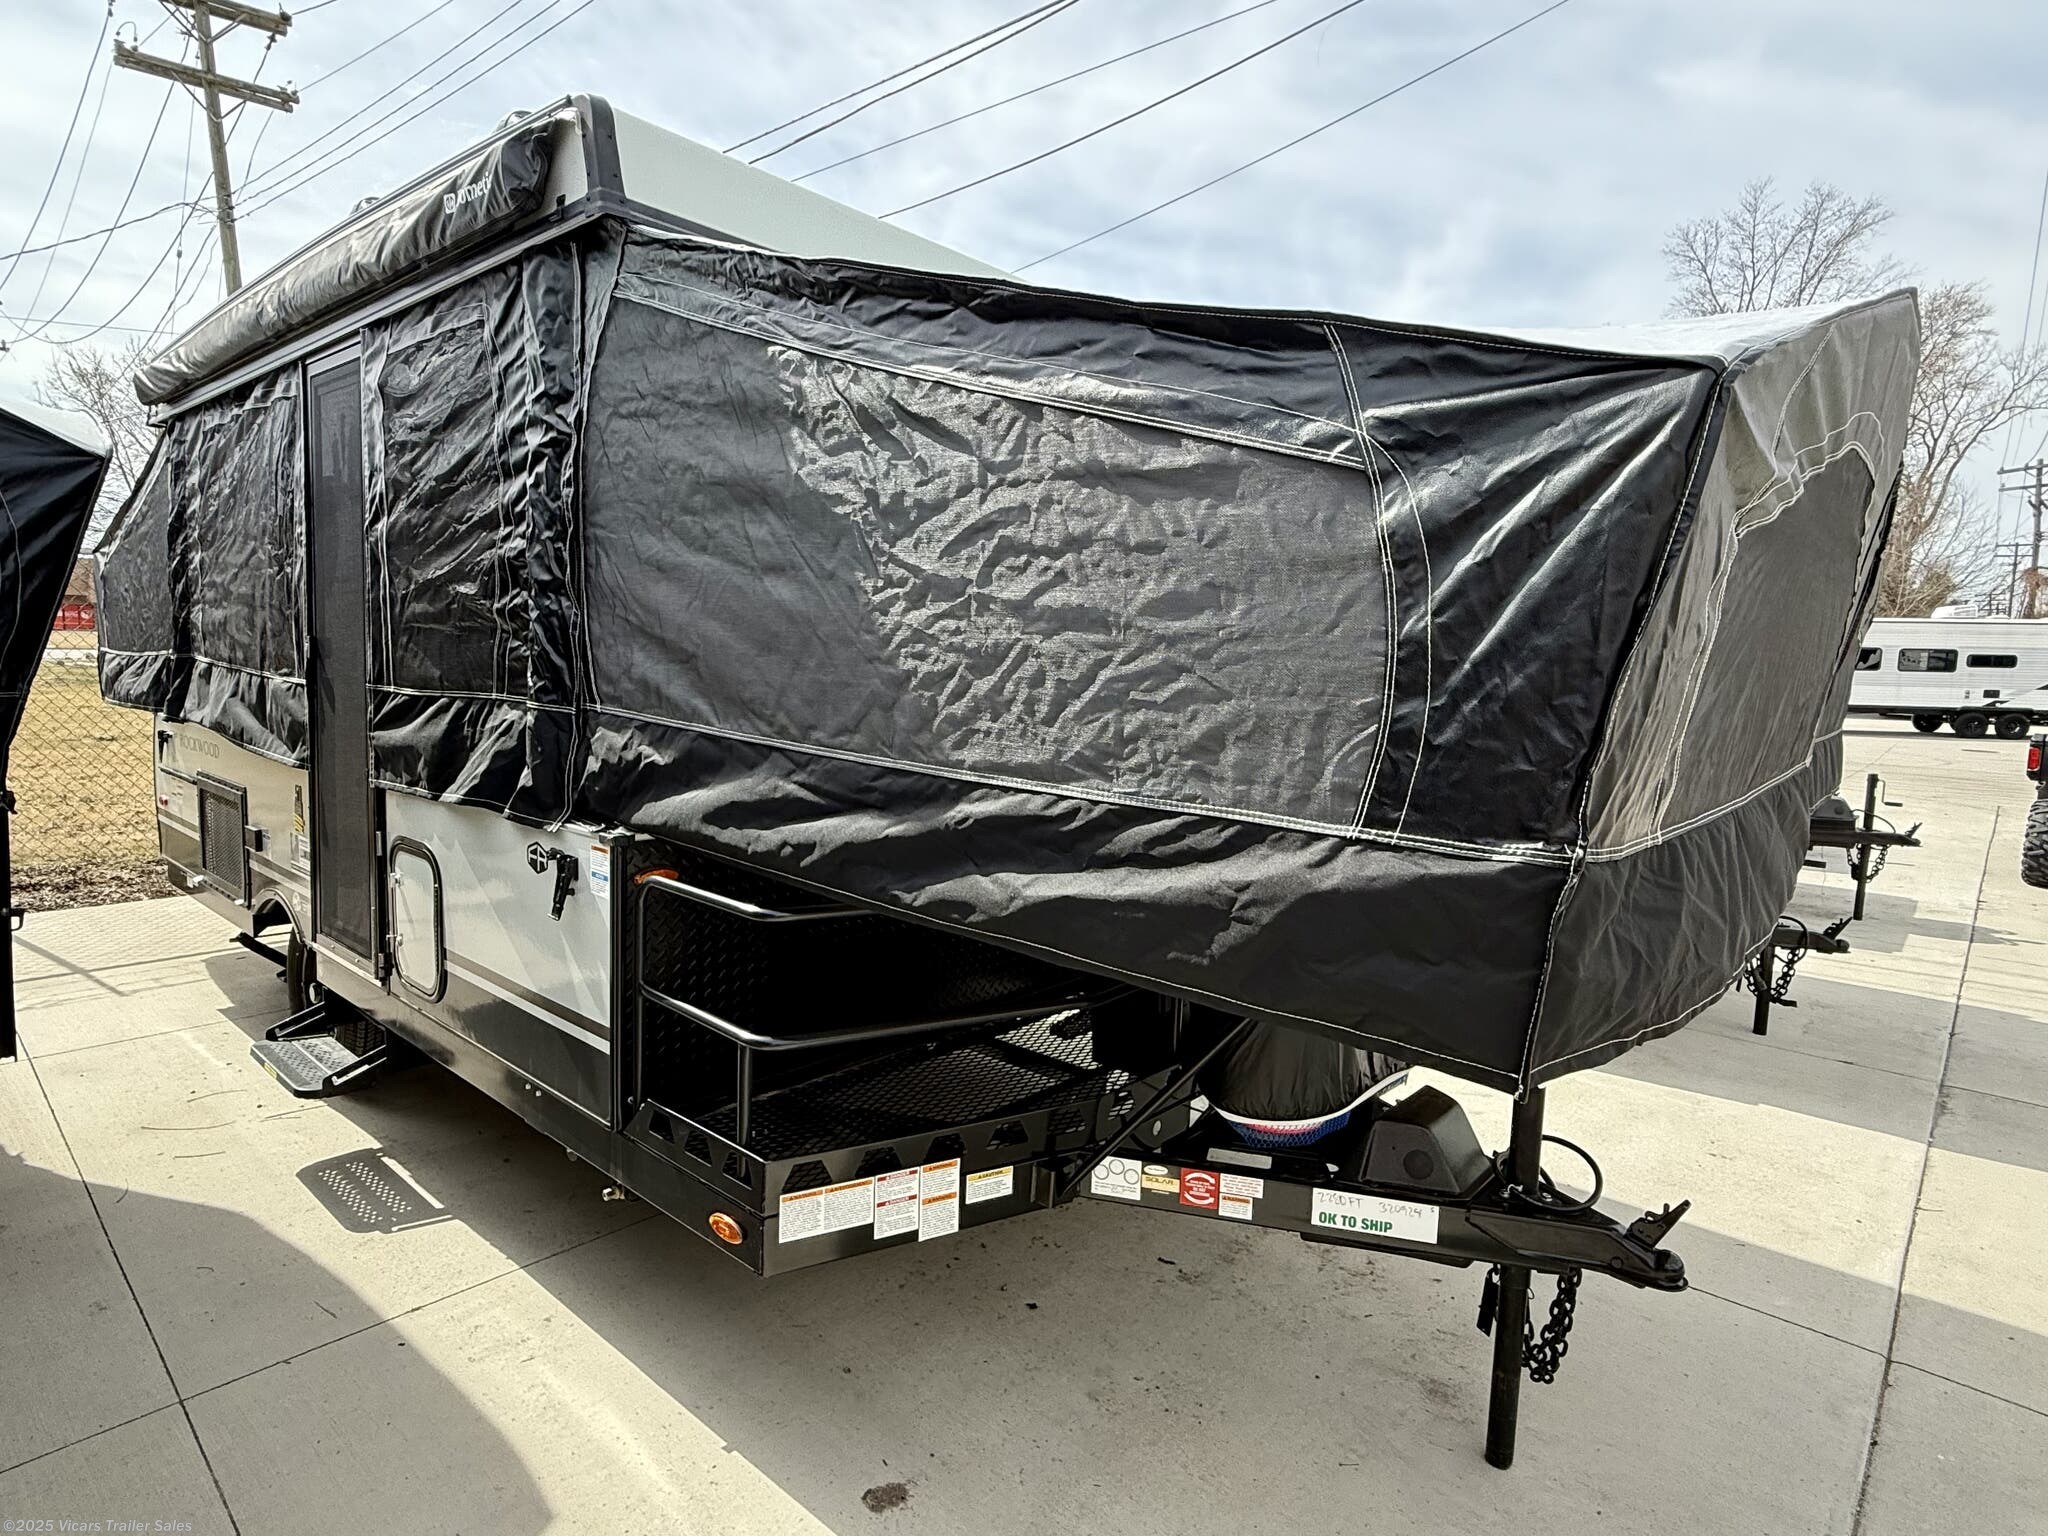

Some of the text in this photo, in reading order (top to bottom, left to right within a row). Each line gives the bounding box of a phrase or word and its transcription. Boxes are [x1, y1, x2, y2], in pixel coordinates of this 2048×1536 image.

[1145, 1176, 1174, 1185] SOLAR
[1318, 1211, 1393, 1233] OK TO SHIP
